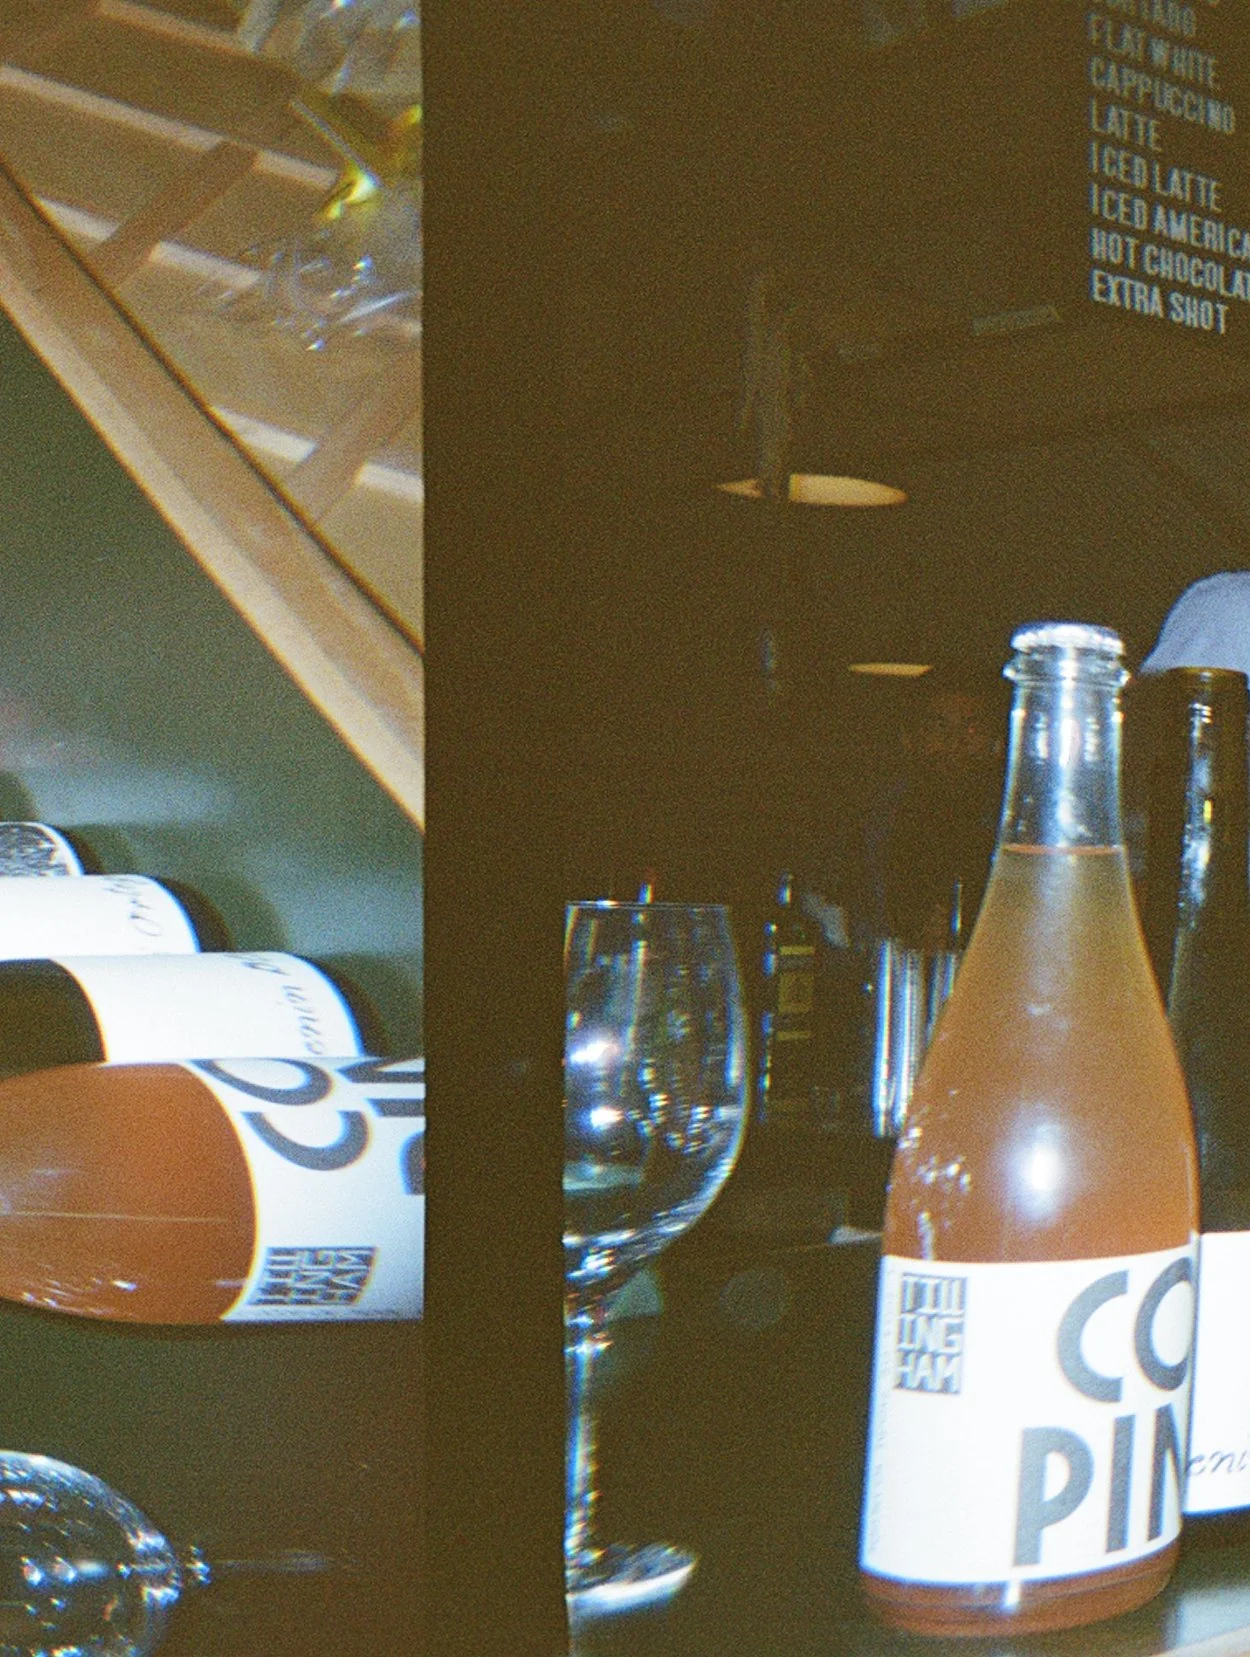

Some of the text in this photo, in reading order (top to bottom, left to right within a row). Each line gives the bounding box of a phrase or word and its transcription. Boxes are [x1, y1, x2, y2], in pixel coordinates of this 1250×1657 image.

[1089, 12, 1220, 91] FLAT WHITE
[1089, 55, 1236, 136] CAPPUCCINO
[1089, 97, 1163, 153] LATTE
[1089, 139, 1224, 213] ICED LATTE
[1089, 181, 1148, 231] ICED
[1089, 227, 1140, 272] HOT
[1089, 267, 1230, 335] EXTRA SHOT
